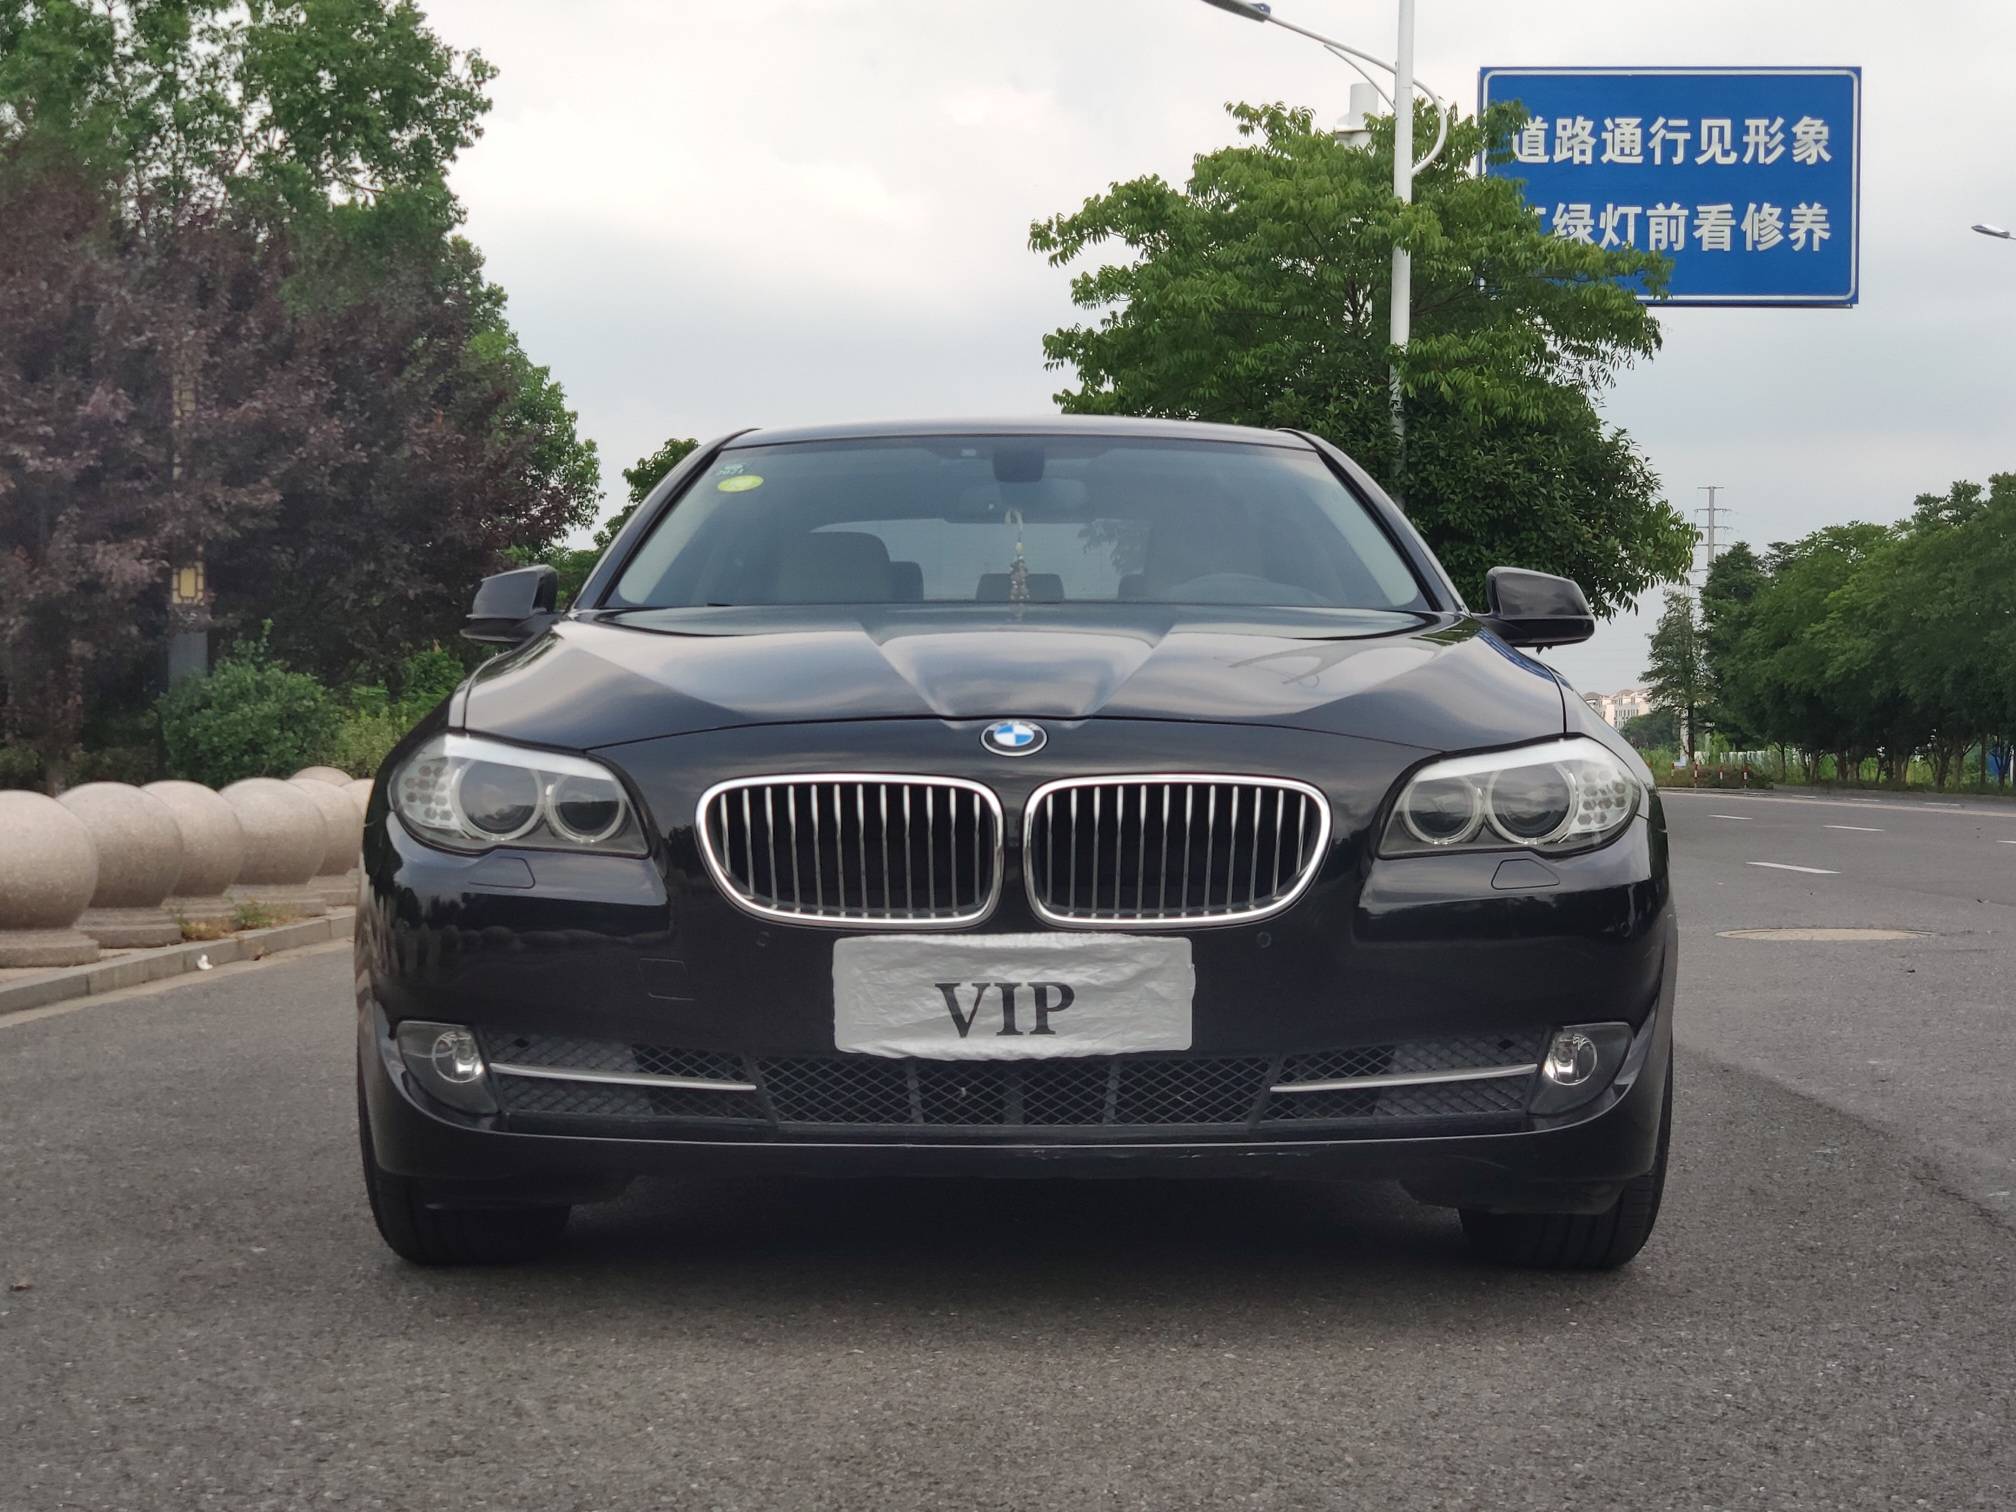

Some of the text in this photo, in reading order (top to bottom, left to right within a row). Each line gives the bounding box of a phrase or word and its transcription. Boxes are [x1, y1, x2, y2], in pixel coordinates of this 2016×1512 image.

[1511, 115, 1832, 165] 道路通行见形象
[1524, 202, 1831, 252] 绿灯前看修养
[934, 981, 1075, 1038] VIP
